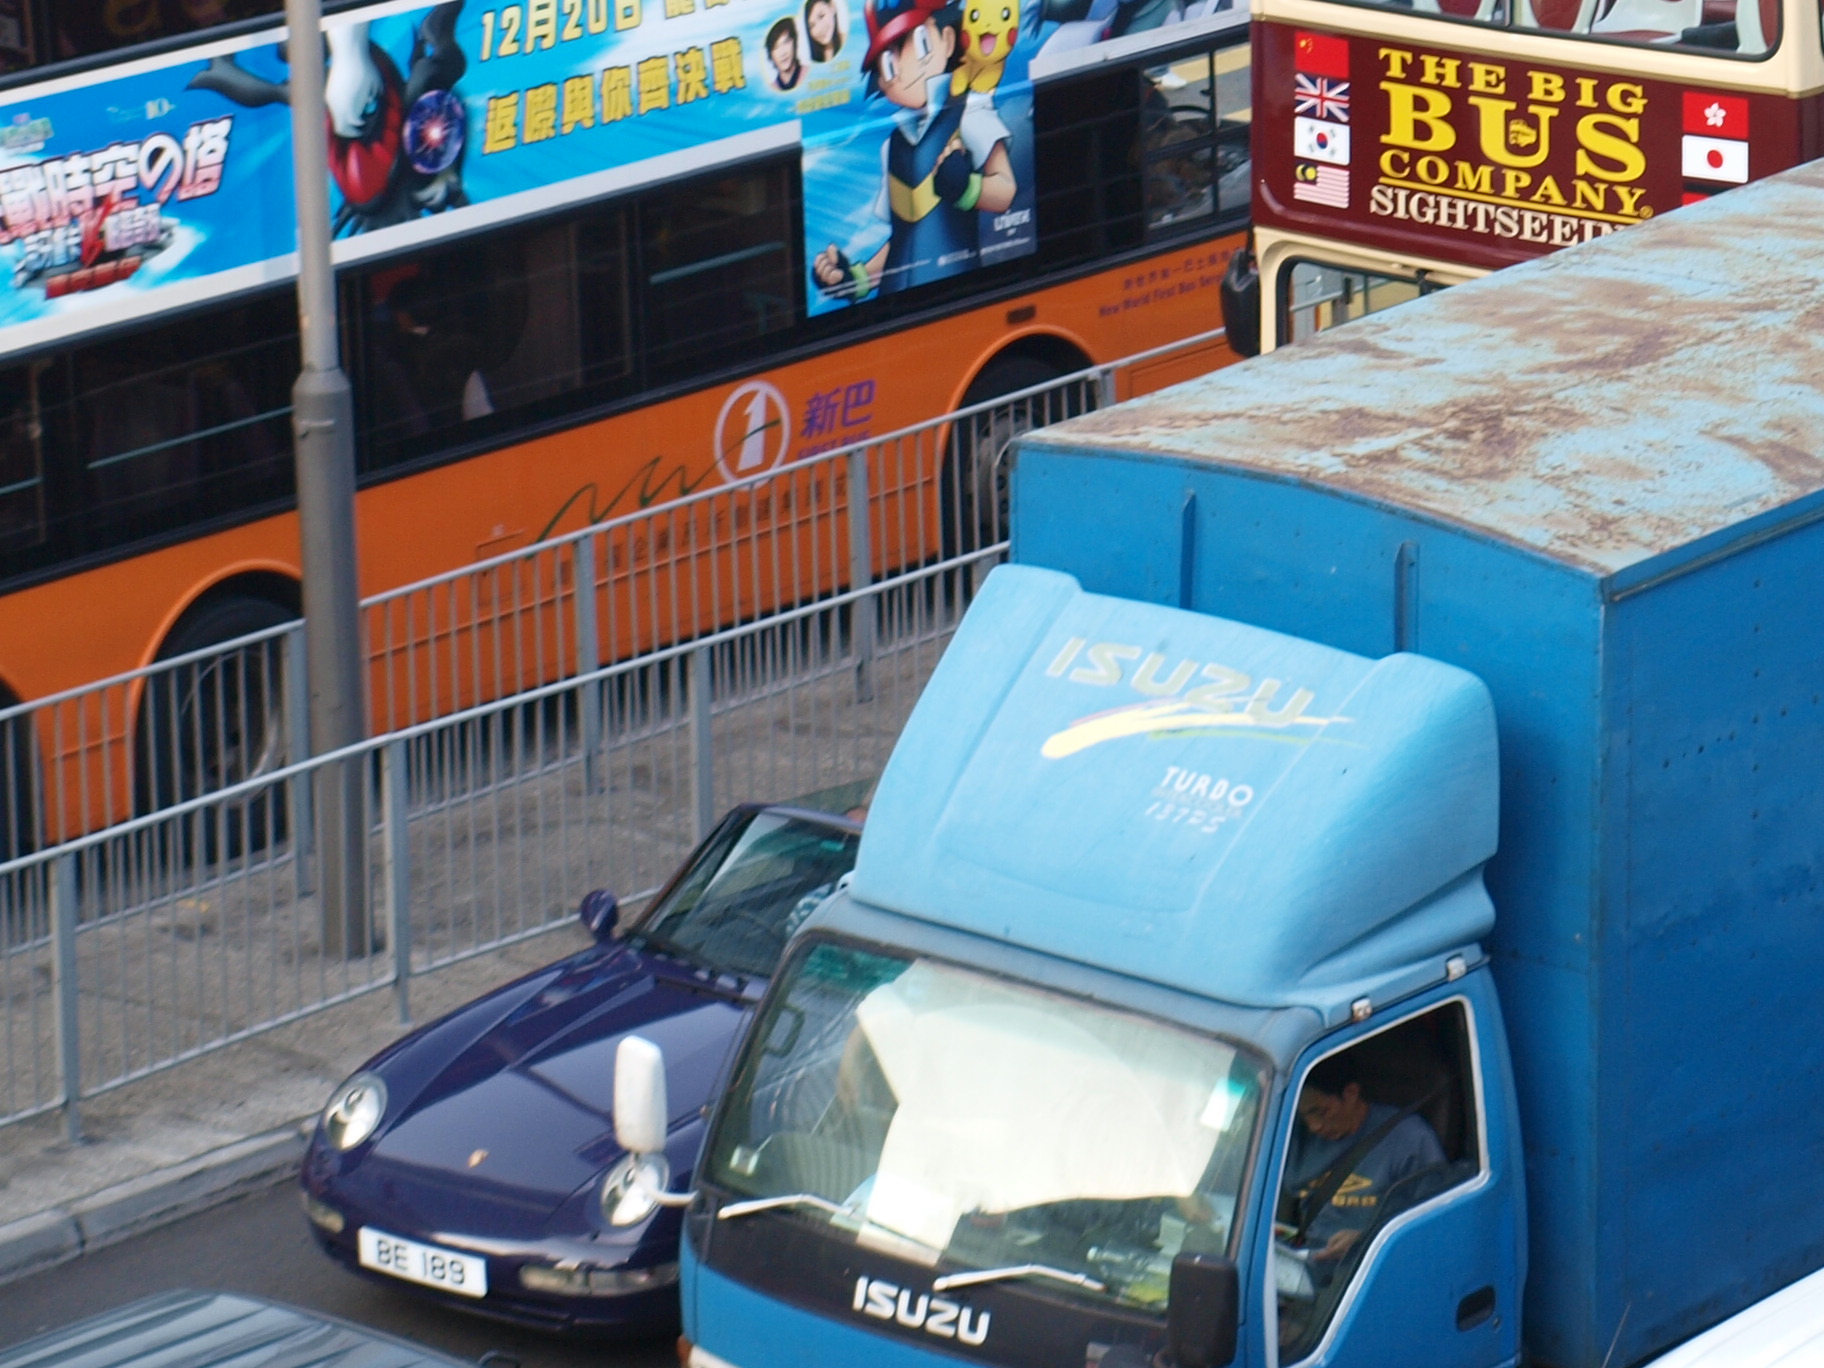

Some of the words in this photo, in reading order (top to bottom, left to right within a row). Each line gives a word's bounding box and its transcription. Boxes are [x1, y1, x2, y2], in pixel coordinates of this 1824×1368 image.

[1378, 47, 1507, 96] THE
[1527, 70, 1648, 114] BIG
[1379, 80, 1647, 182] BUS
[1378, 148, 1647, 217] COMPANY
[800, 379, 876, 439] 新巴
[1045, 636, 1315, 728] ISUZU
[1160, 766, 1255, 808] TURBO
[377, 1238, 408, 1271] BE
[853, 1275, 991, 1346] ISUZU
